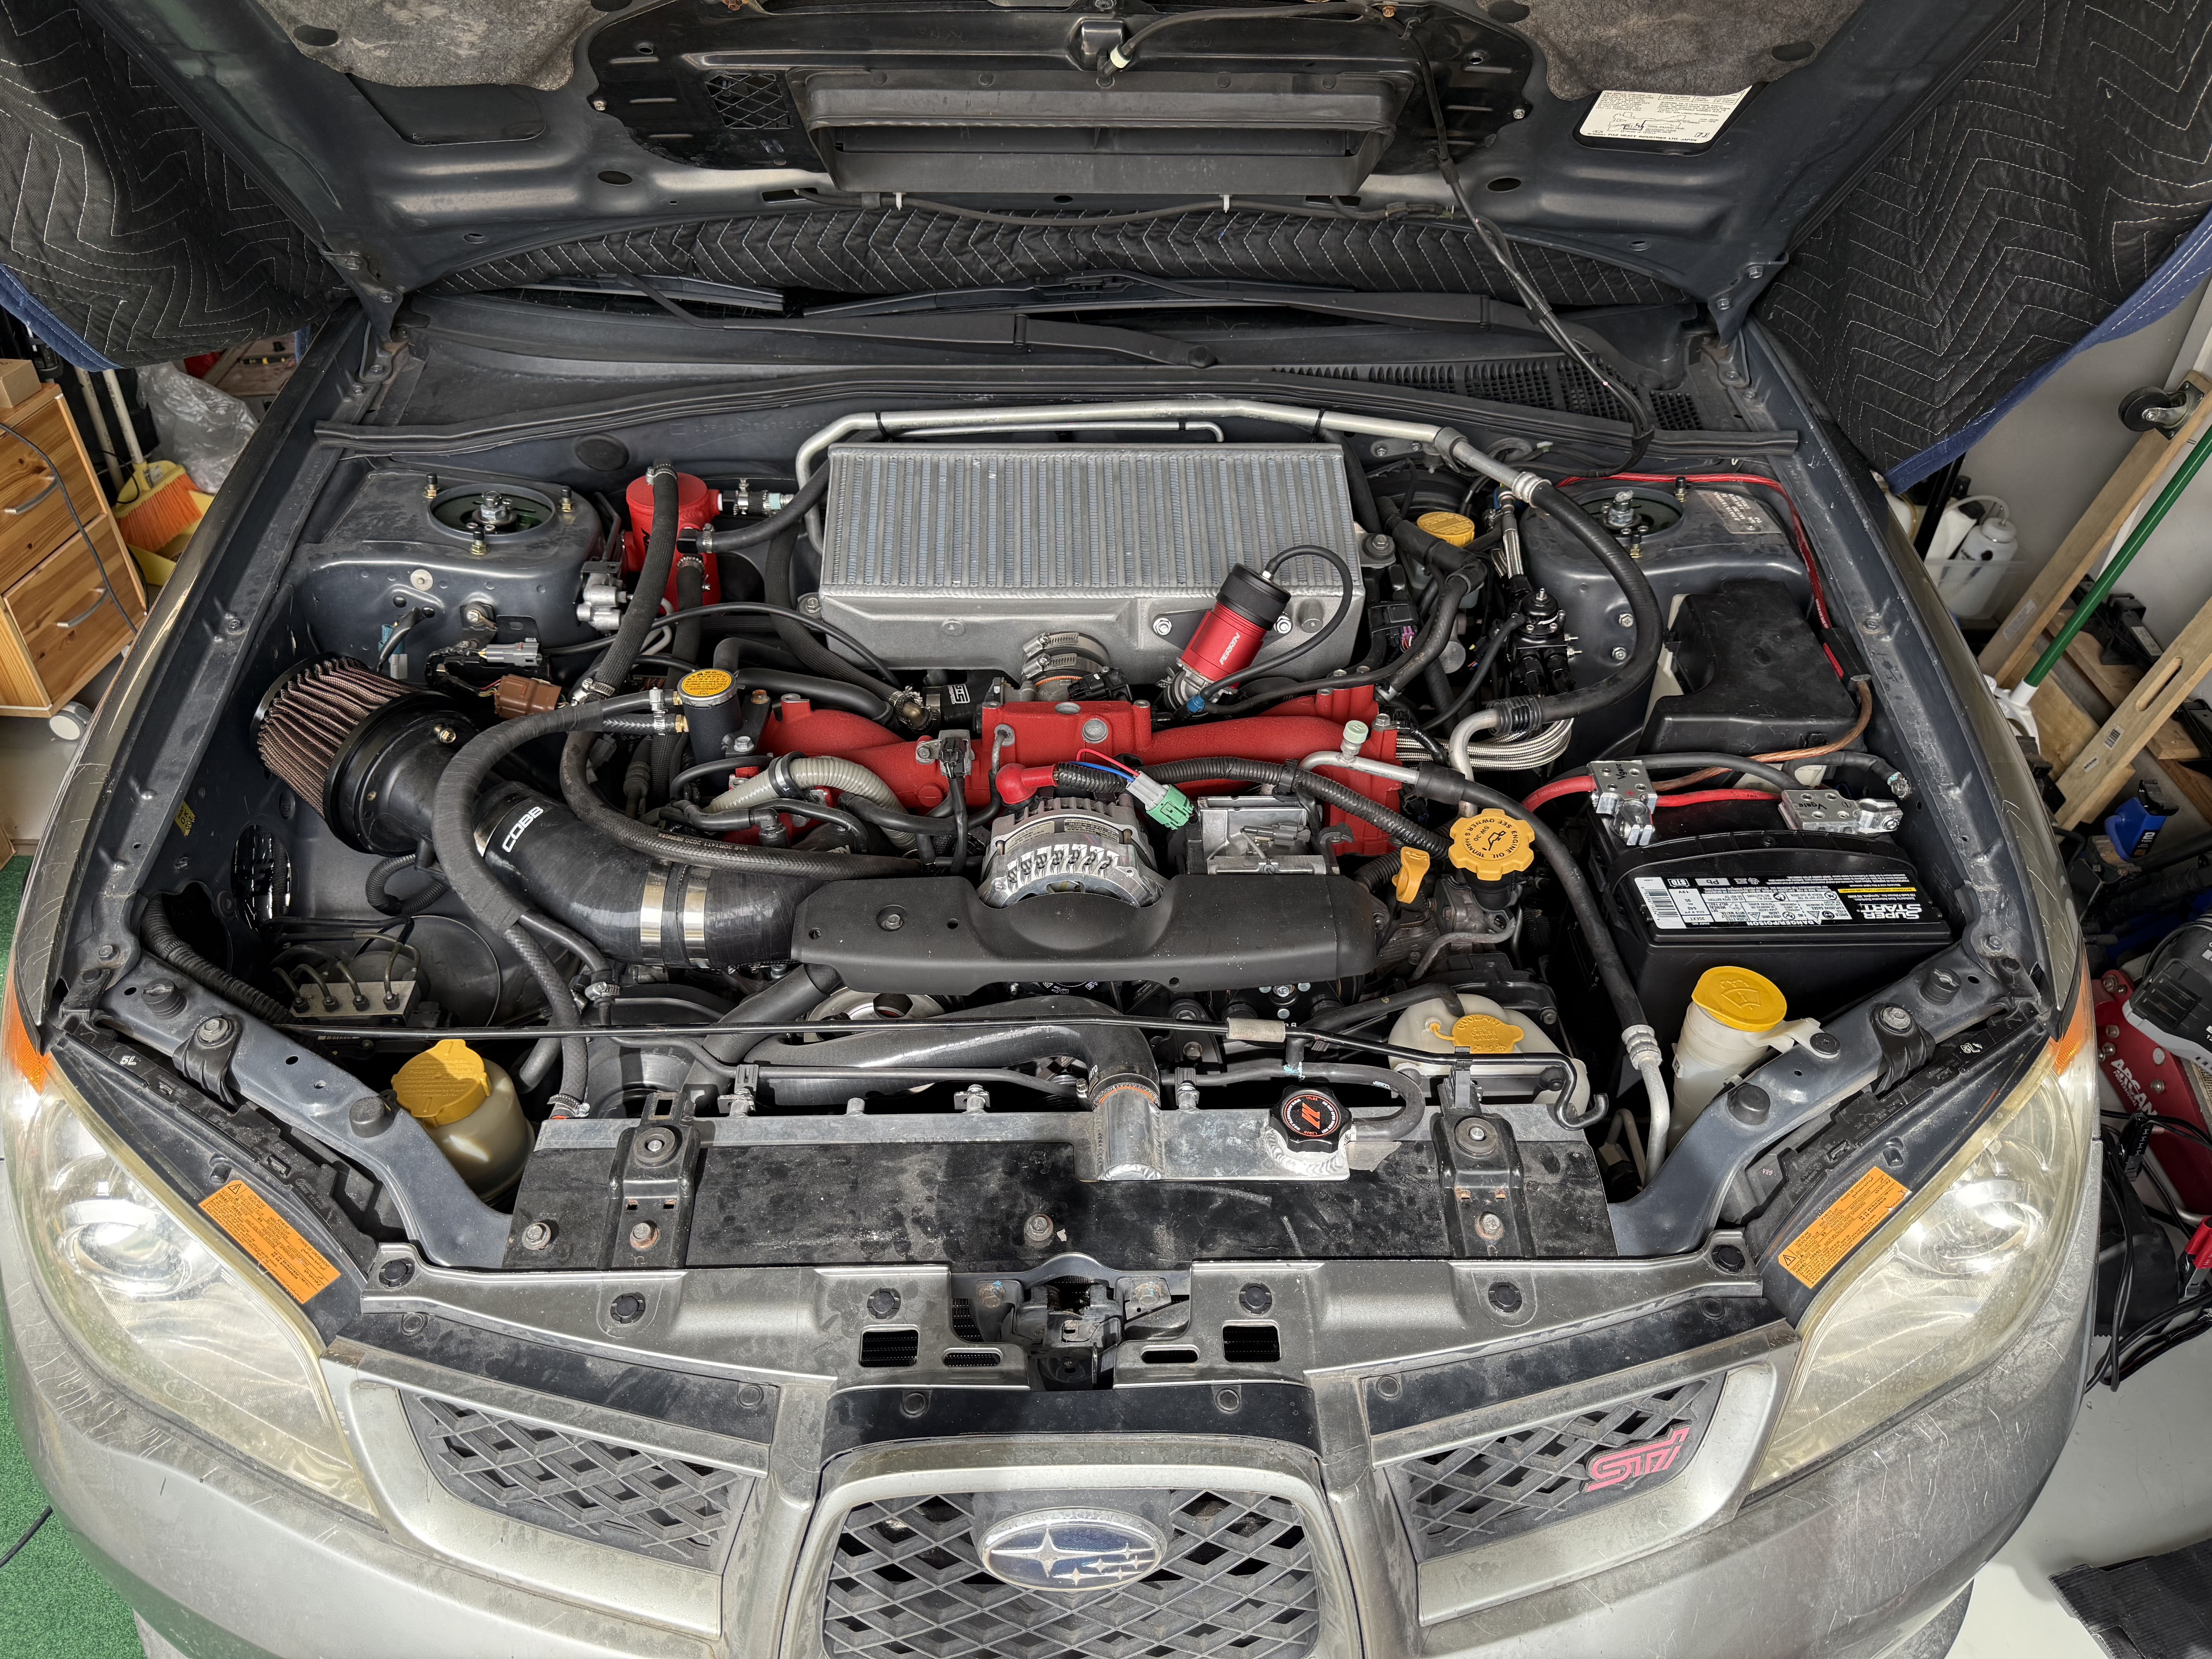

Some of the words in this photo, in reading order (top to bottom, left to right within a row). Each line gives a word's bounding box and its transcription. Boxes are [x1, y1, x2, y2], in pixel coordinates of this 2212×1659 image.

[1219, 632, 1241, 666] PERRIN
[1616, 763, 1627, 780] Vgate
[501, 805, 544, 853] COBB
[1497, 820, 1512, 828] SEE
[1474, 826, 1489, 841] 5W-30
[2143, 831, 2156, 840] 2
[1464, 839, 1485, 858] MANUAL
[1505, 831, 1518, 854] ENGINE
[1860, 904, 1922, 912] START
[1456, 1015, 1504, 1030] COOLANT
[120, 1055, 137, 1065] 5L
[2111, 1059, 2158, 1116] ARCAN
[2113, 1070, 2138, 1106] PROFESSIONAL
